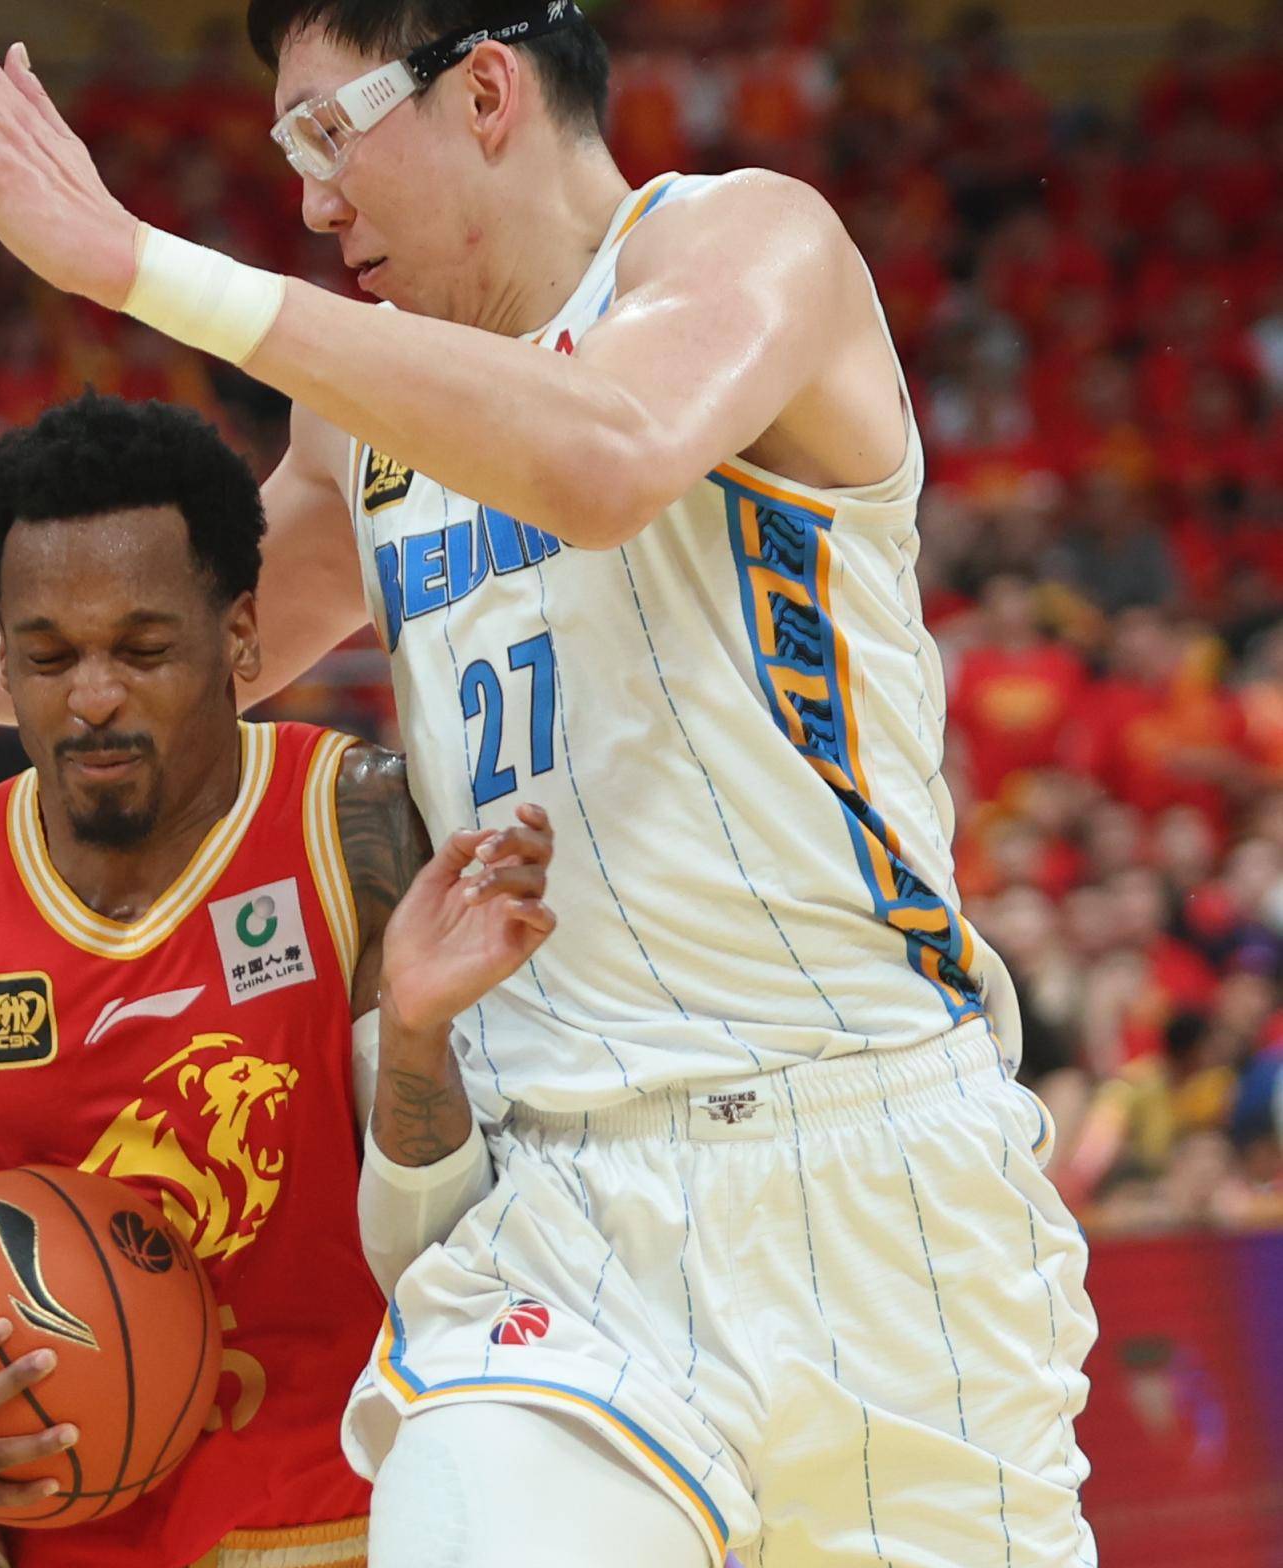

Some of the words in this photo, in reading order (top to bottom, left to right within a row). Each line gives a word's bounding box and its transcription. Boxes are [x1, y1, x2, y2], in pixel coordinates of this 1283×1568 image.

[374, 504, 562, 655] BEIJI
[460, 630, 556, 808] 27
[235, 972, 273, 993] CHINA
[275, 961, 305, 978] LIFE
[707, 1090, 757, 1105] DUCKS
